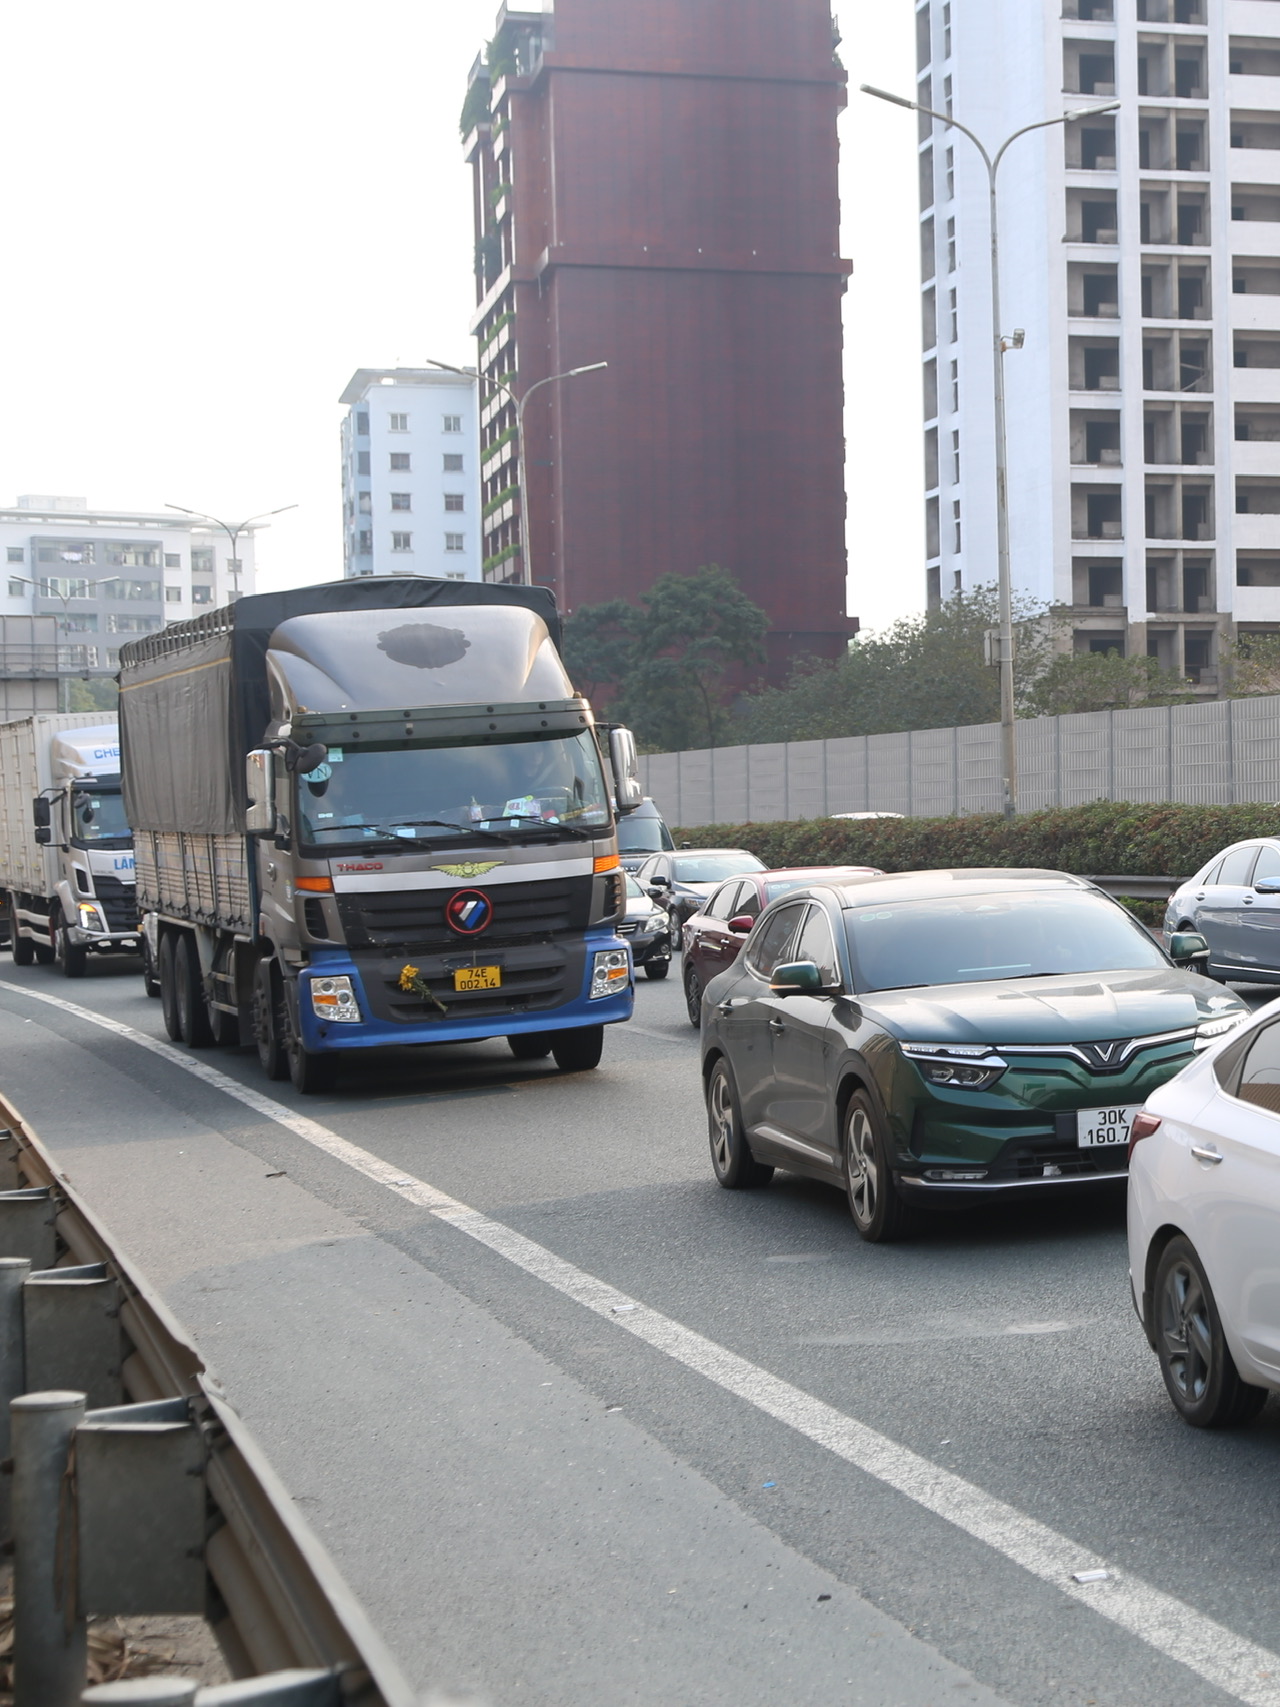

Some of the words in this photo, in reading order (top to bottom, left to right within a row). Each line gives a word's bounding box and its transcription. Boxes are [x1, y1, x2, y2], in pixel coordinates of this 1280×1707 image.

[336, 862, 384, 872] THACO
[467, 968, 487, 979] 74E
[460, 978, 496, 990] 002.14
[1098, 1109, 1127, 1126] 30K
[1087, 1126, 1130, 1145] 160.7
